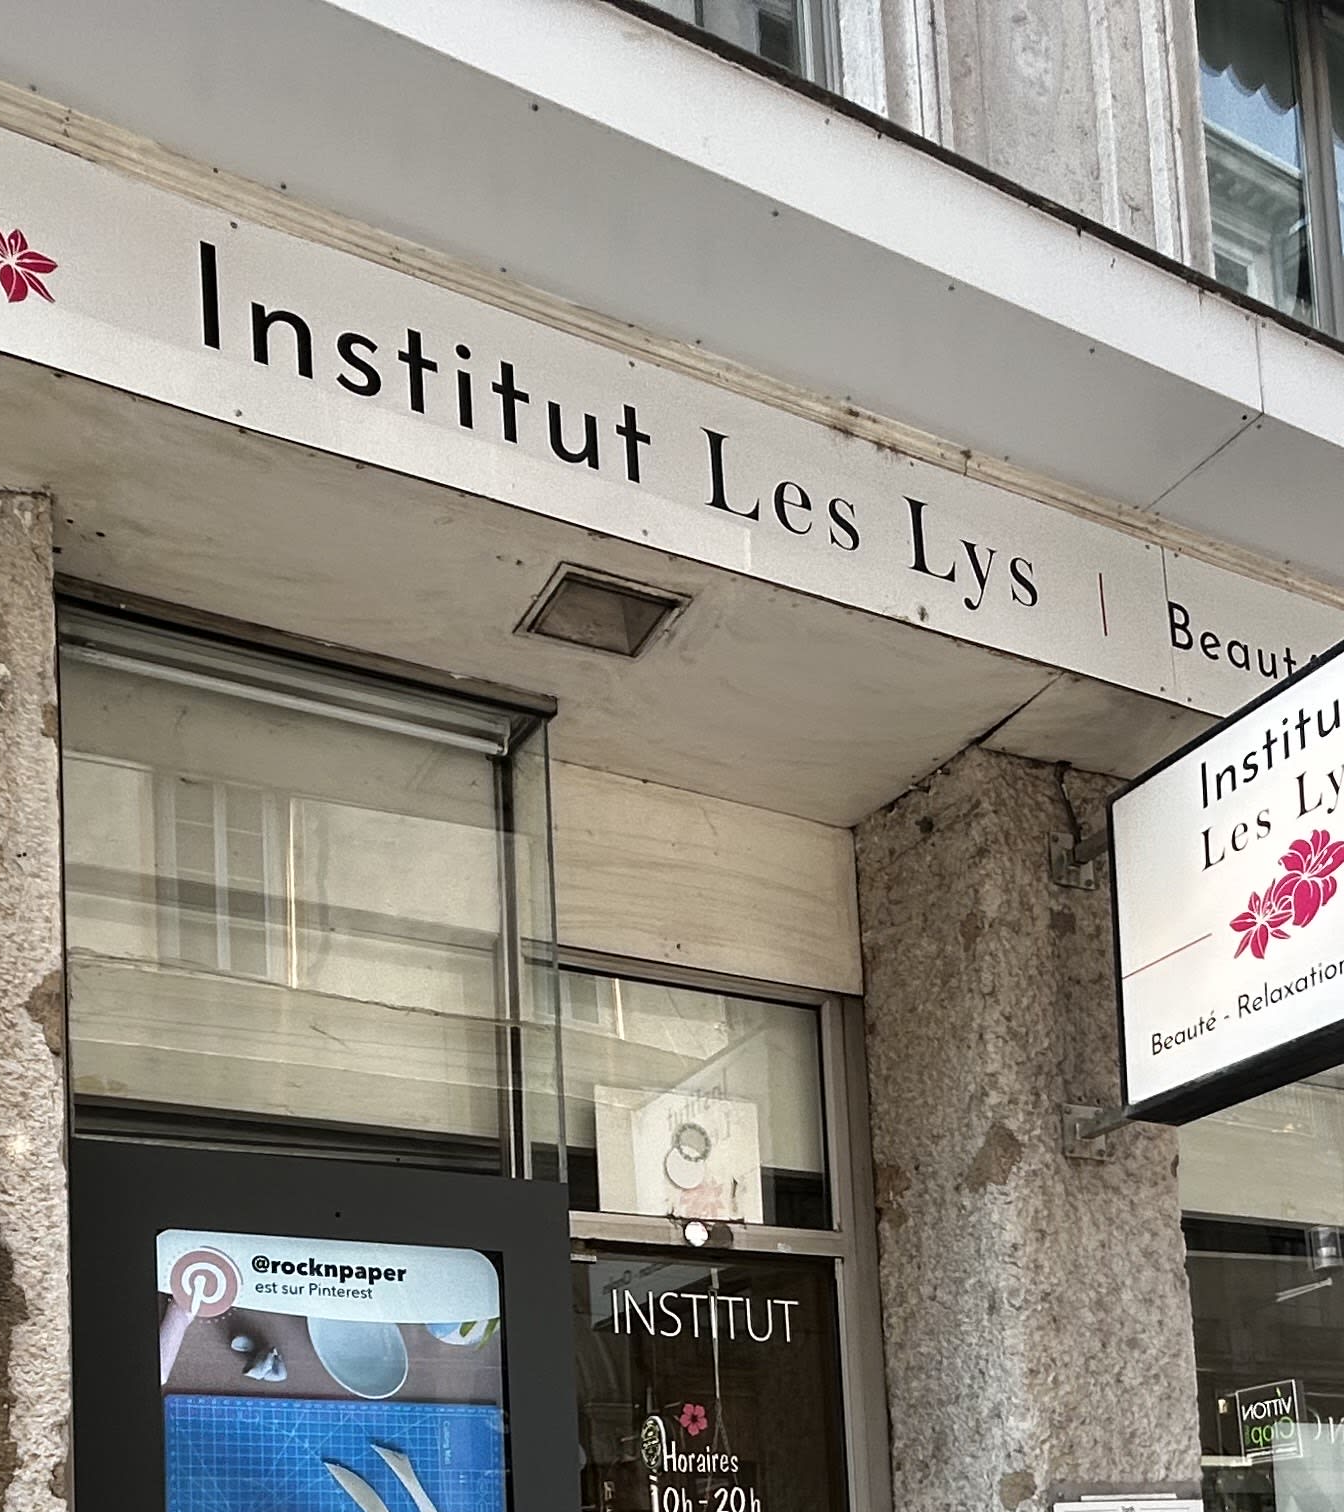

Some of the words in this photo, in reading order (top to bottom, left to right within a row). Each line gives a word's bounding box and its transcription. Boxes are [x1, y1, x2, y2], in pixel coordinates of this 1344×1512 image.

[200, 240, 651, 484] Institut
[700, 427, 860, 552] Les
[902, 494, 1040, 612] Lys
[1167, 600, 1321, 679] Beaut
[1200, 808, 1272, 871] Les
[1151, 1010, 1216, 1056] Beauté
[251, 1255, 406, 1285] @rocknpaper
[255, 1281, 278, 1294] est
[281, 1284, 305, 1296] sur
[309, 1282, 373, 1300] Pinterest
[612, 1288, 799, 1343] INSTITUT
[662, 1440, 739, 1473] Horaires
